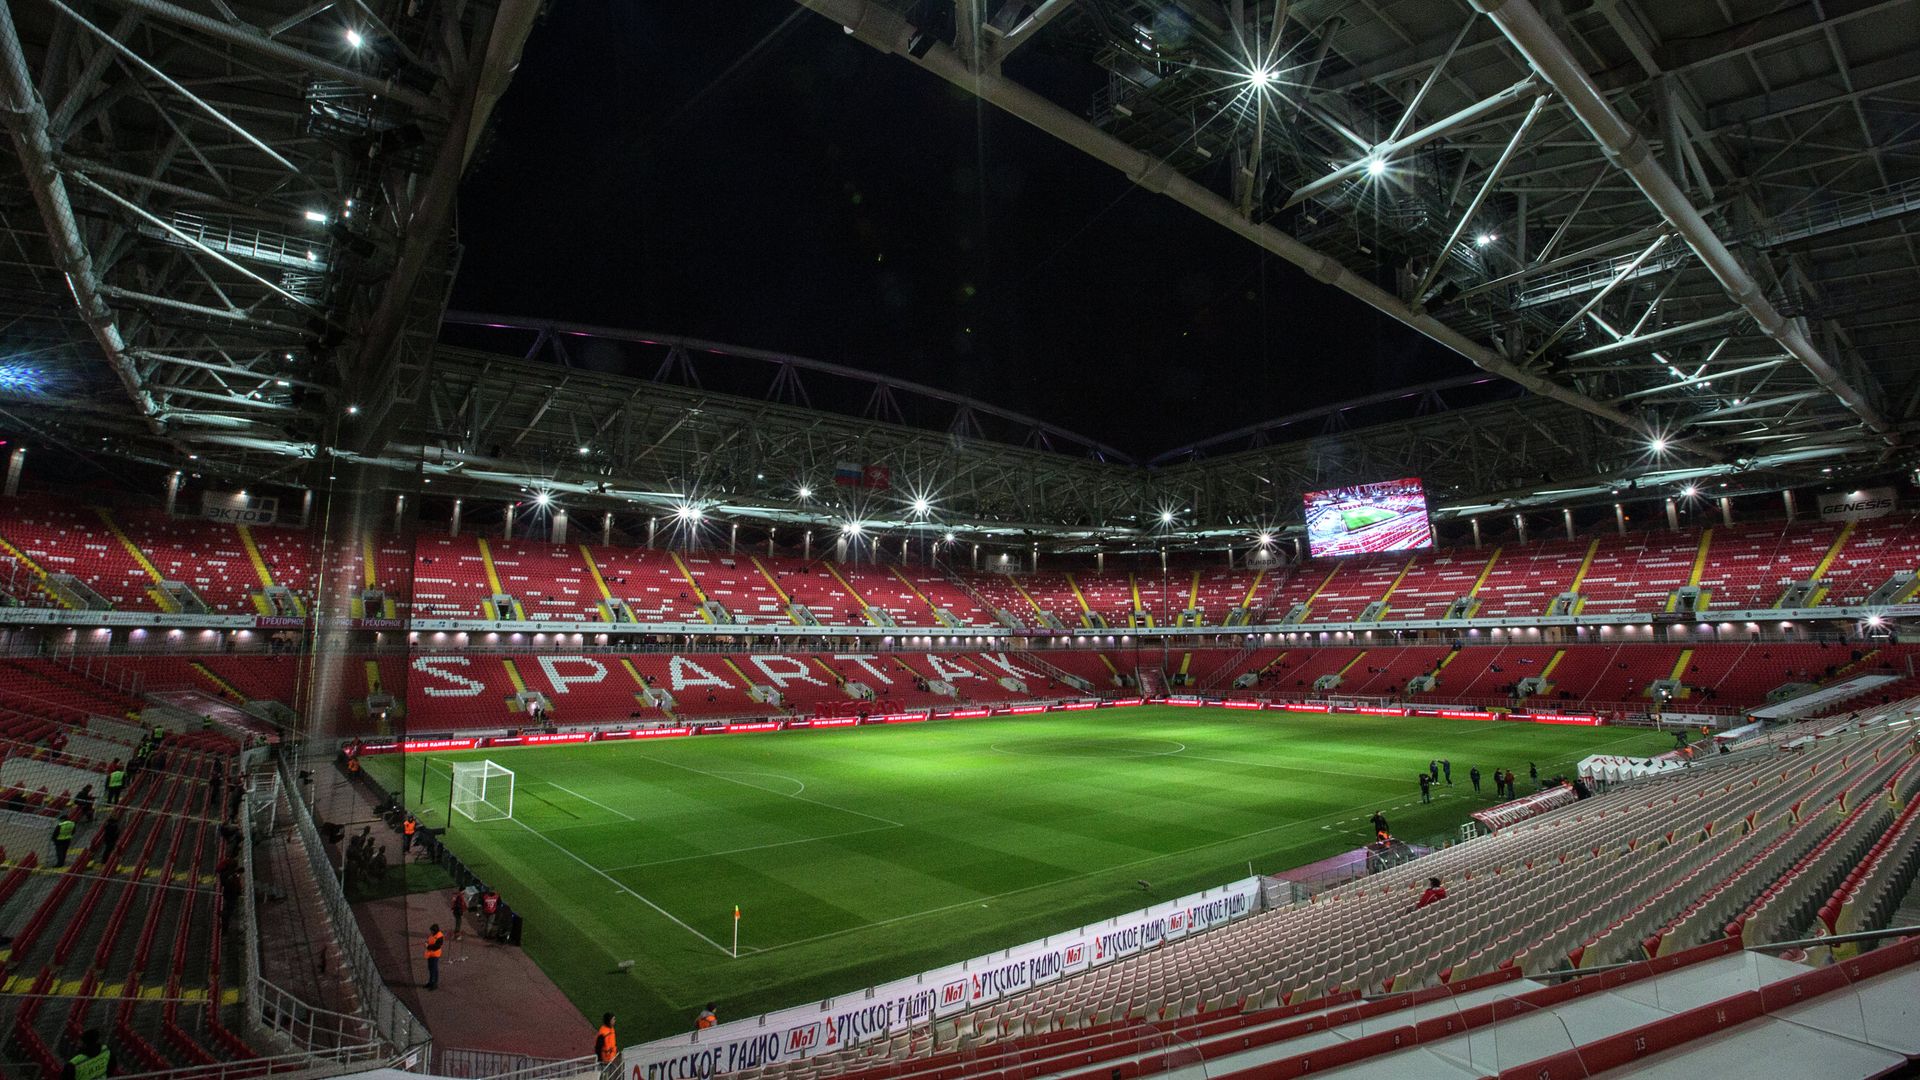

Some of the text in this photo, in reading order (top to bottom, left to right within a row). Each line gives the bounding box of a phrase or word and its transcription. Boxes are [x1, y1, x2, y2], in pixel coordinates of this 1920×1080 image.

[1823, 499, 1892, 514] GENESIS
[412, 652, 1046, 696] SPARTAK
[1224, 893, 1245, 918] РАДИО
[1102, 926, 1138, 956] РУССКОЕ
[1140, 918, 1165, 942] РАДИО
[981, 961, 1026, 998] РУССКОЕ
[1030, 952, 1061, 982] РАДИО
[837, 1003, 893, 1042] РУССКОЕ
[730, 1032, 780, 1073] РАДИО
[1636, 1038, 1646, 1051] 13
[1304, 1060, 1309, 1070] 7
